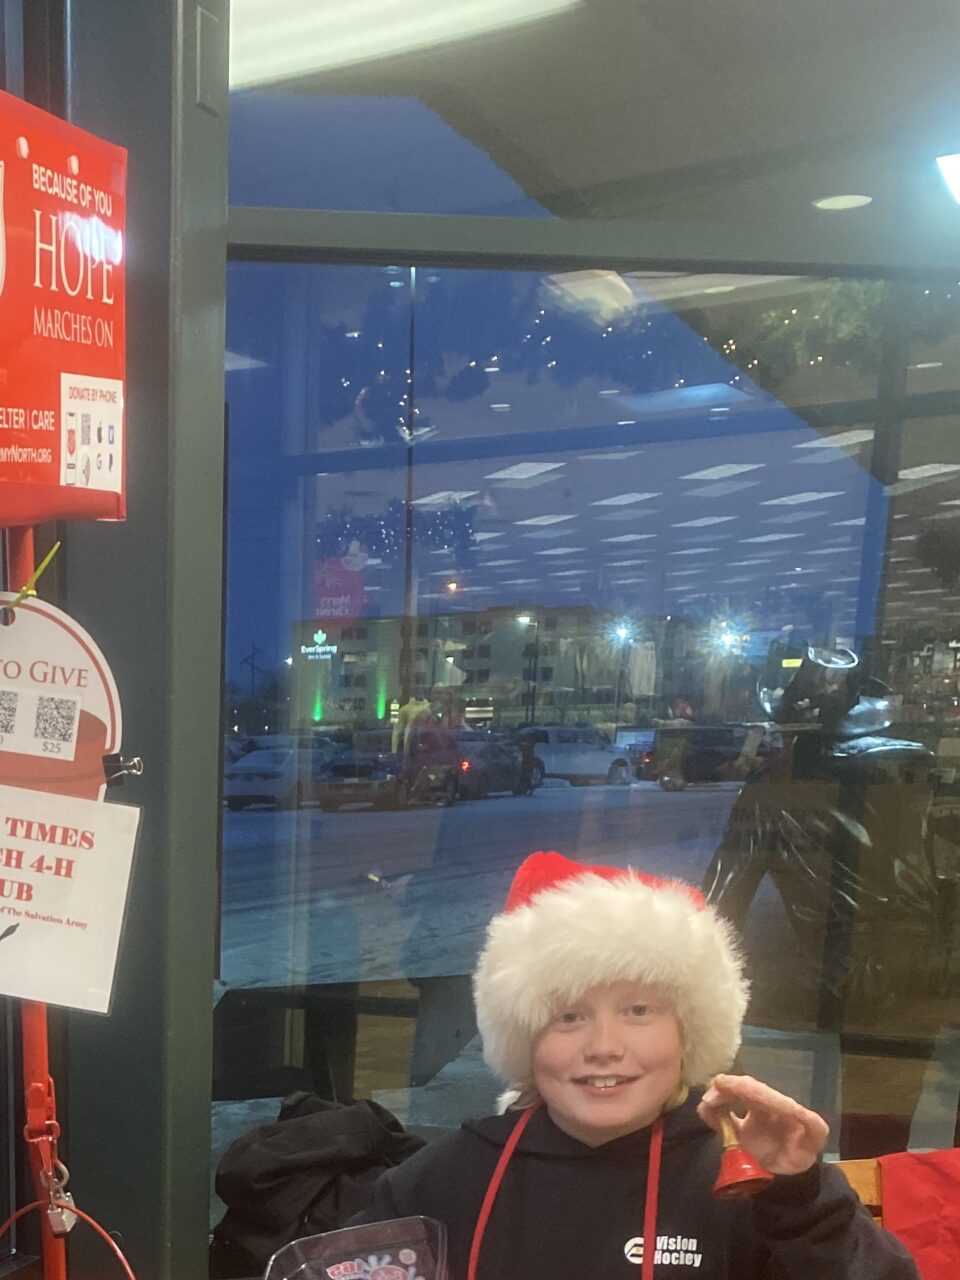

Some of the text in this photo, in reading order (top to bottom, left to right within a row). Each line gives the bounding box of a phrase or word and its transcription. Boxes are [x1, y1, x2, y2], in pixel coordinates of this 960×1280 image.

[32, 163, 112, 217] BECAUSE OF YOU
[33, 305, 114, 348] MARCHES ON
[69, 386, 118, 404] DONATE BY PHONE
[31, 411, 56, 431] CARE
[42, 741, 62, 754] $25
[5, 816, 95, 850] TIMES
[29, 854, 75, 878] 4-H
[6, 907, 22, 917] The
[24, 911, 63, 925] Salvation
[65, 918, 88, 930] Army
[656, 1235, 698, 1251] Vision
[653, 1250, 703, 1267] Hockey
